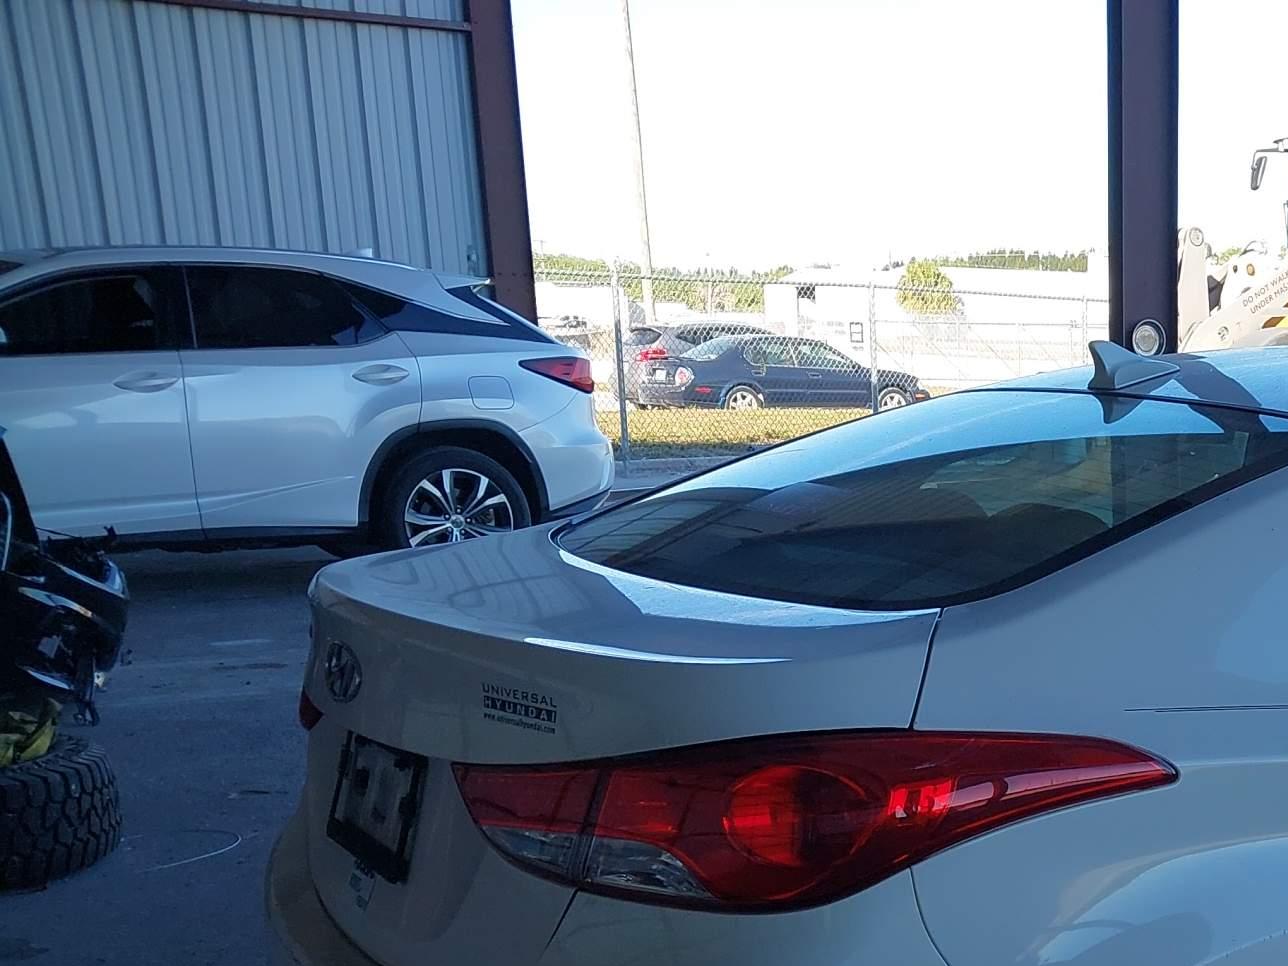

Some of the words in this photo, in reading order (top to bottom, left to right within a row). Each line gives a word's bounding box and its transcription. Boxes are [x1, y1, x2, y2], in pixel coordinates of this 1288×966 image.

[1242, 295, 1254, 307] DO
[1254, 284, 1270, 299] NOT
[1250, 294, 1274, 314] UNDER
[482, 683, 557, 708] UNIVERSAL
[484, 695, 557, 723] HYUNDAI
